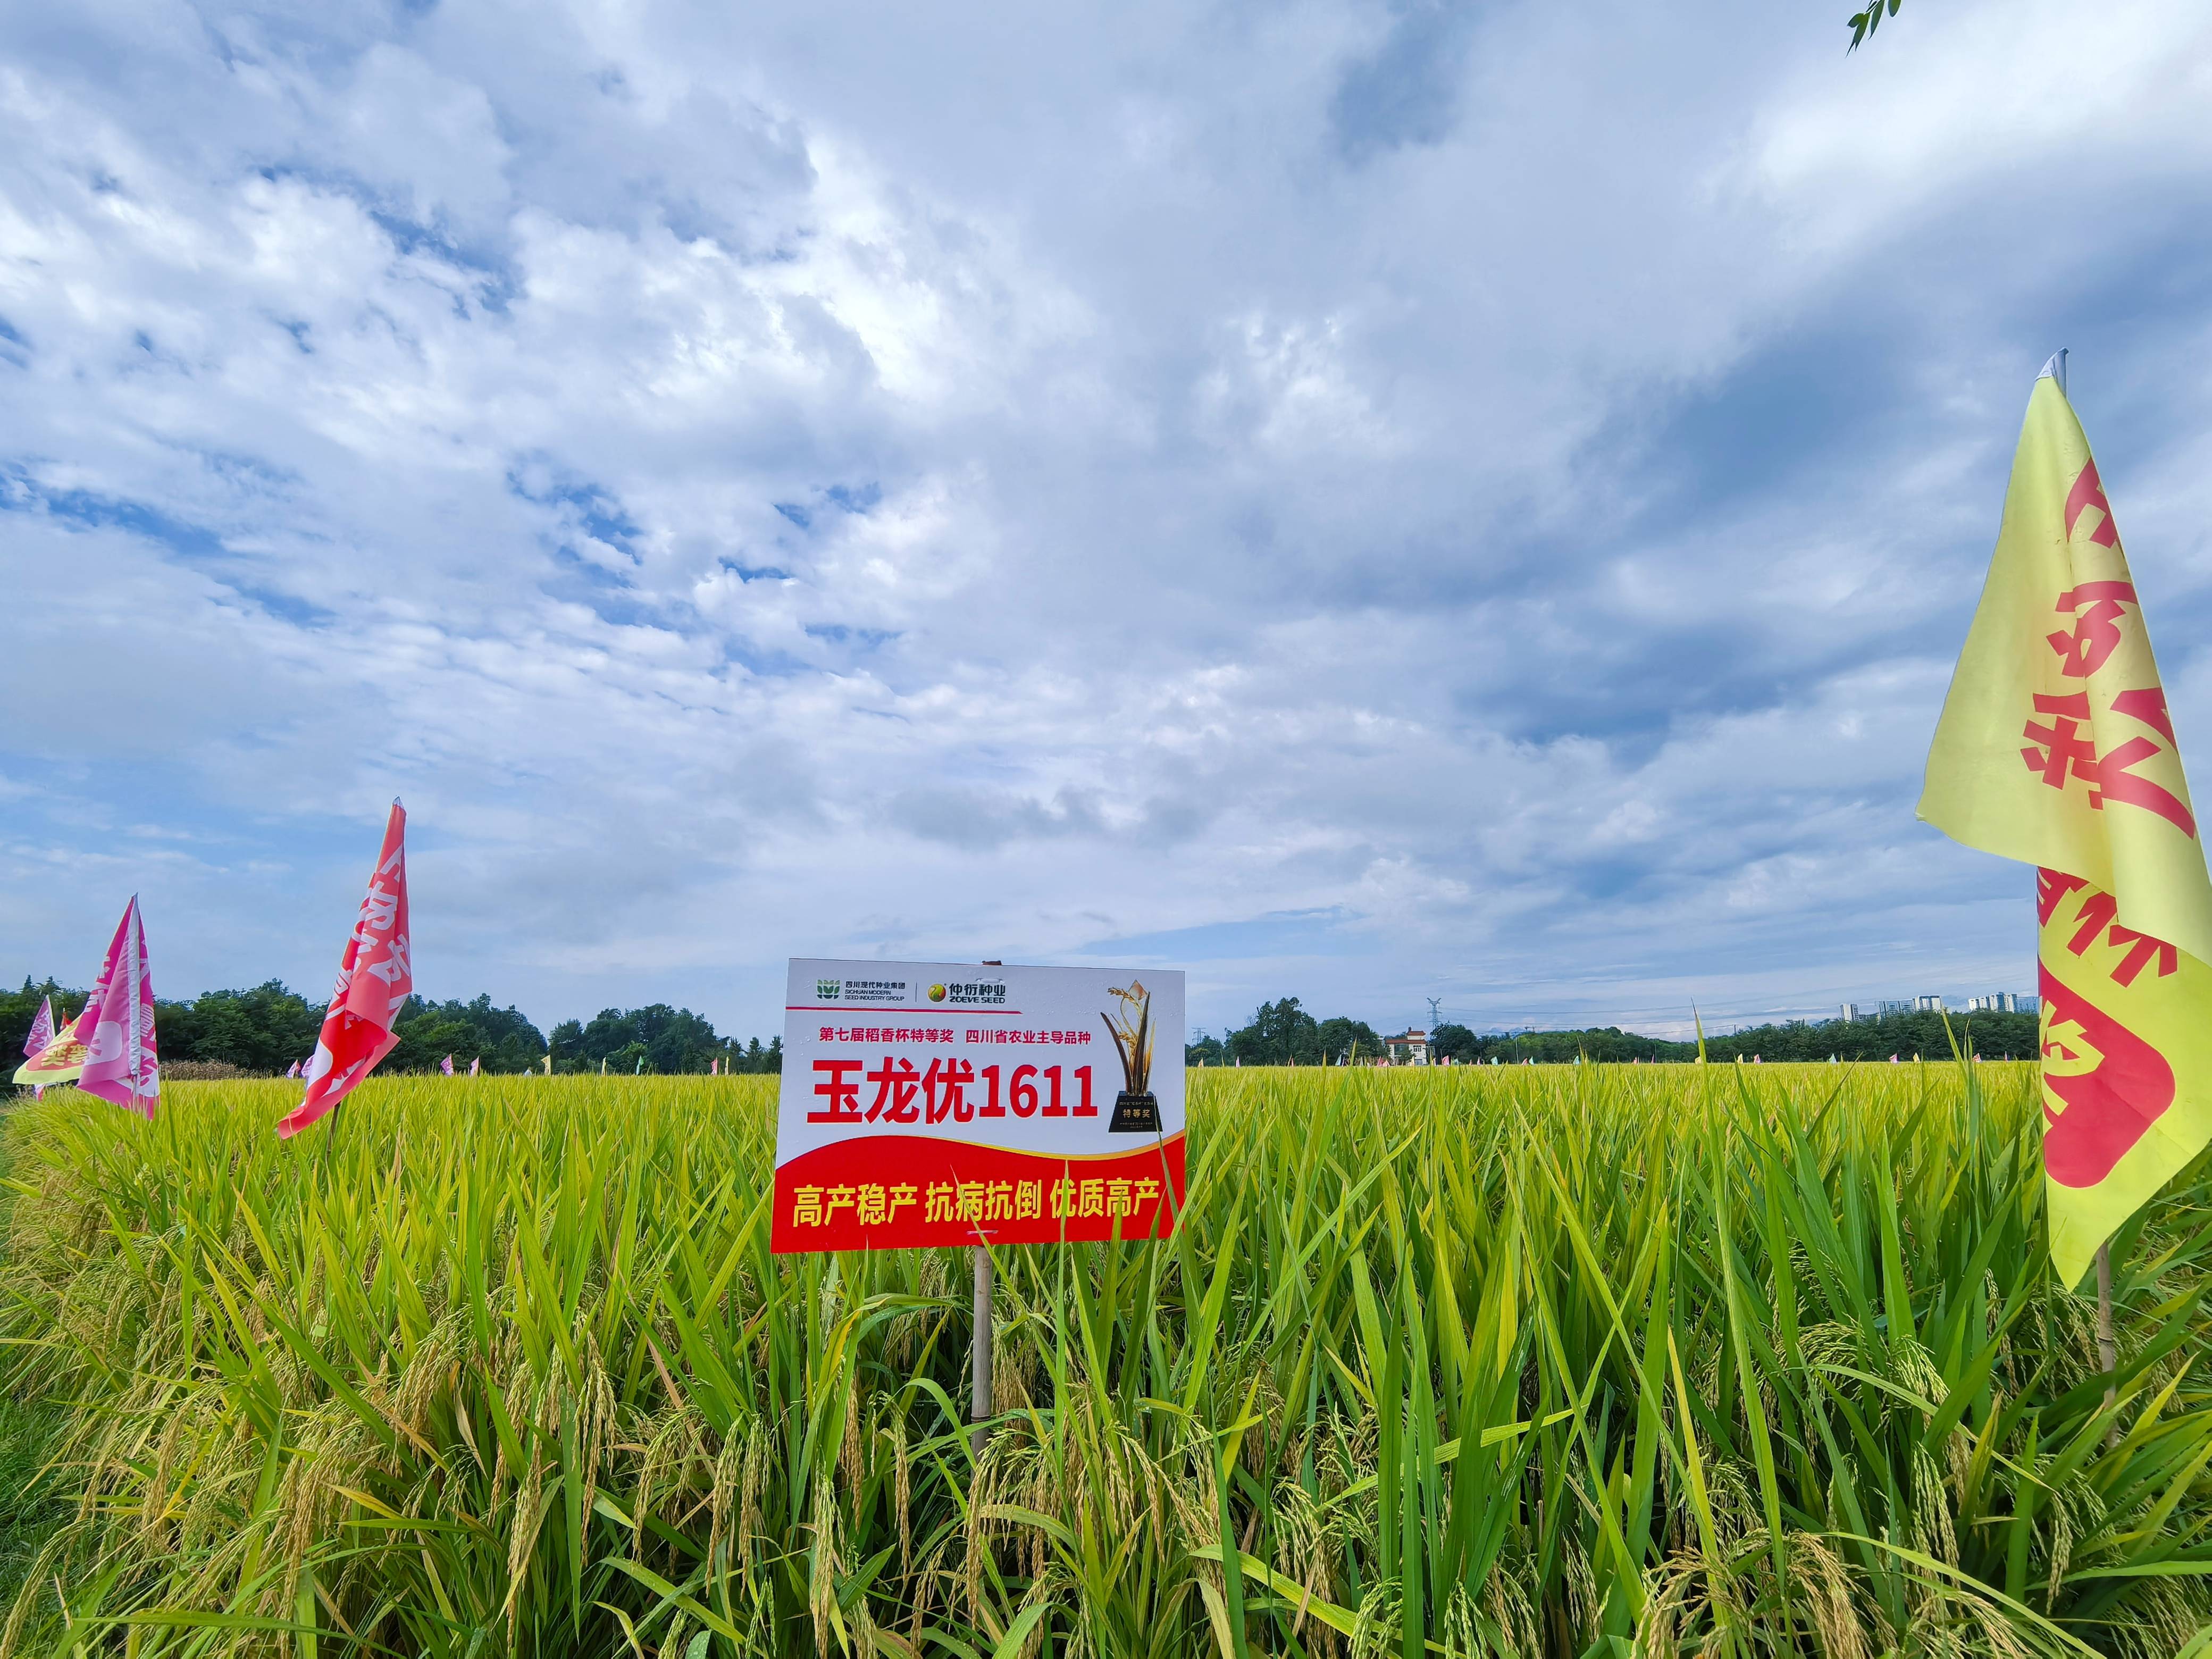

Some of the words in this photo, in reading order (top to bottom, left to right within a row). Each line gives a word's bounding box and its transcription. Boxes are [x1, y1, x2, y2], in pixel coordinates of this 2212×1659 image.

[949, 983, 1006, 996] 仲衍种业
[819, 1026, 954, 1043] 第七届稻香杯特等奖
[965, 1029, 1091, 1045] 四川省农业主导品种
[807, 1055, 1098, 1125] 玉龙优1611
[1122, 1109, 1151, 1119] 特等奖
[793, 1183, 918, 1228] 高产稳产
[925, 1178, 1042, 1224] 抗病抗倒
[1050, 1176, 1160, 1219] 优质高产
